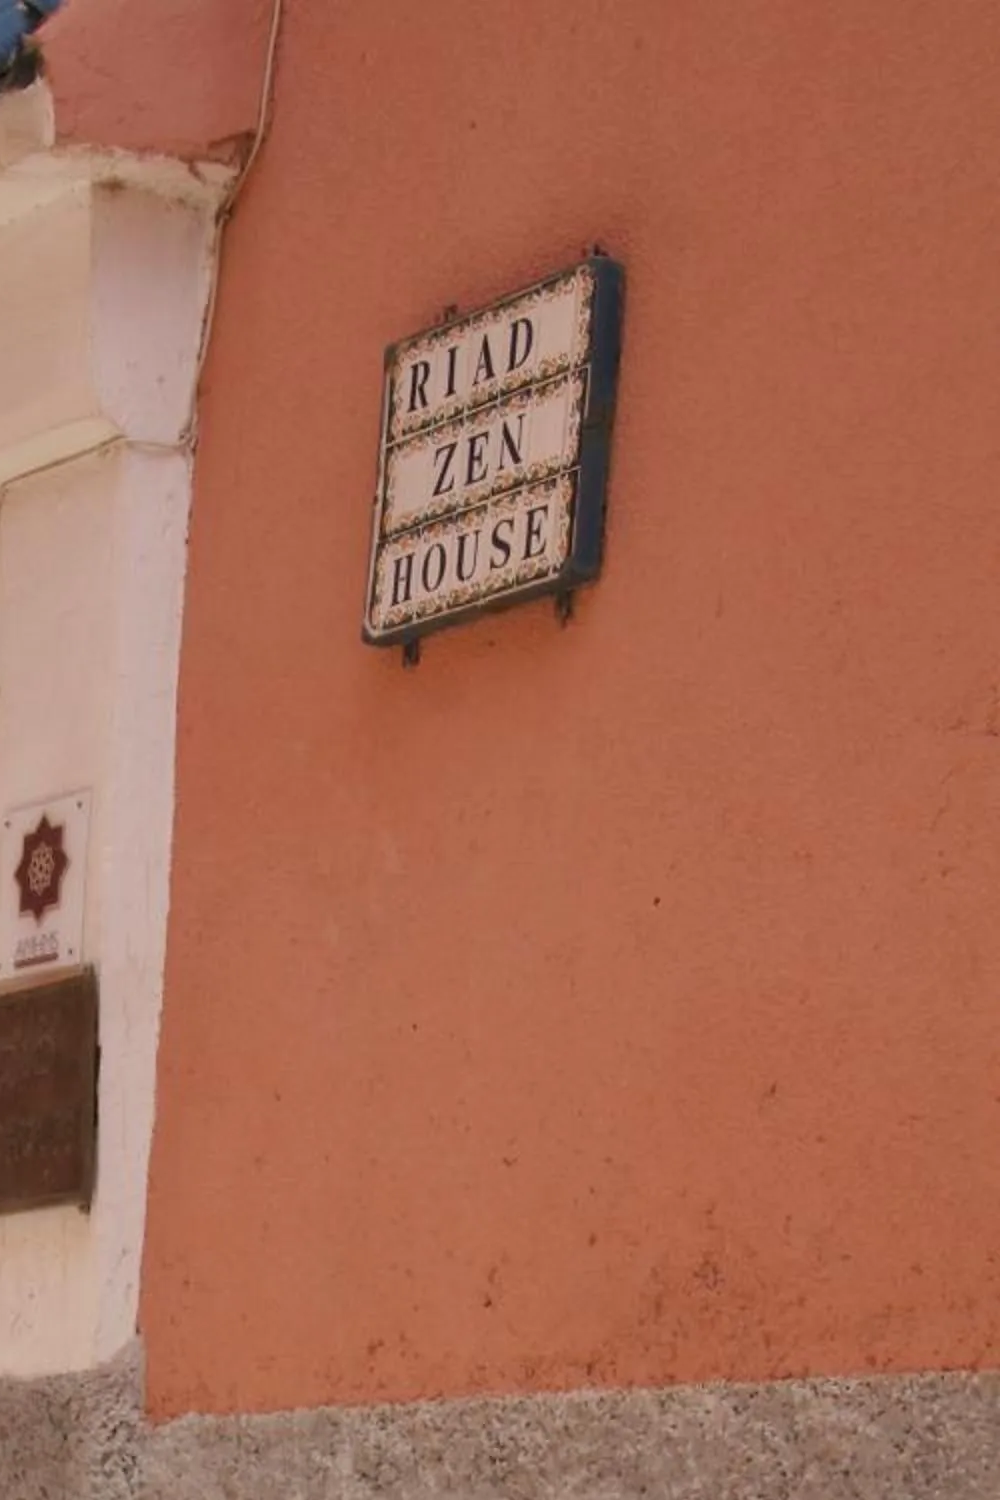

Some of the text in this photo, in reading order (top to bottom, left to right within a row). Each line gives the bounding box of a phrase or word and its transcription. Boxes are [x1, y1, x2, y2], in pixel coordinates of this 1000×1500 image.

[407, 316, 534, 413] RIAD
[432, 413, 526, 497] ZEN
[390, 505, 549, 606] HOUSE
